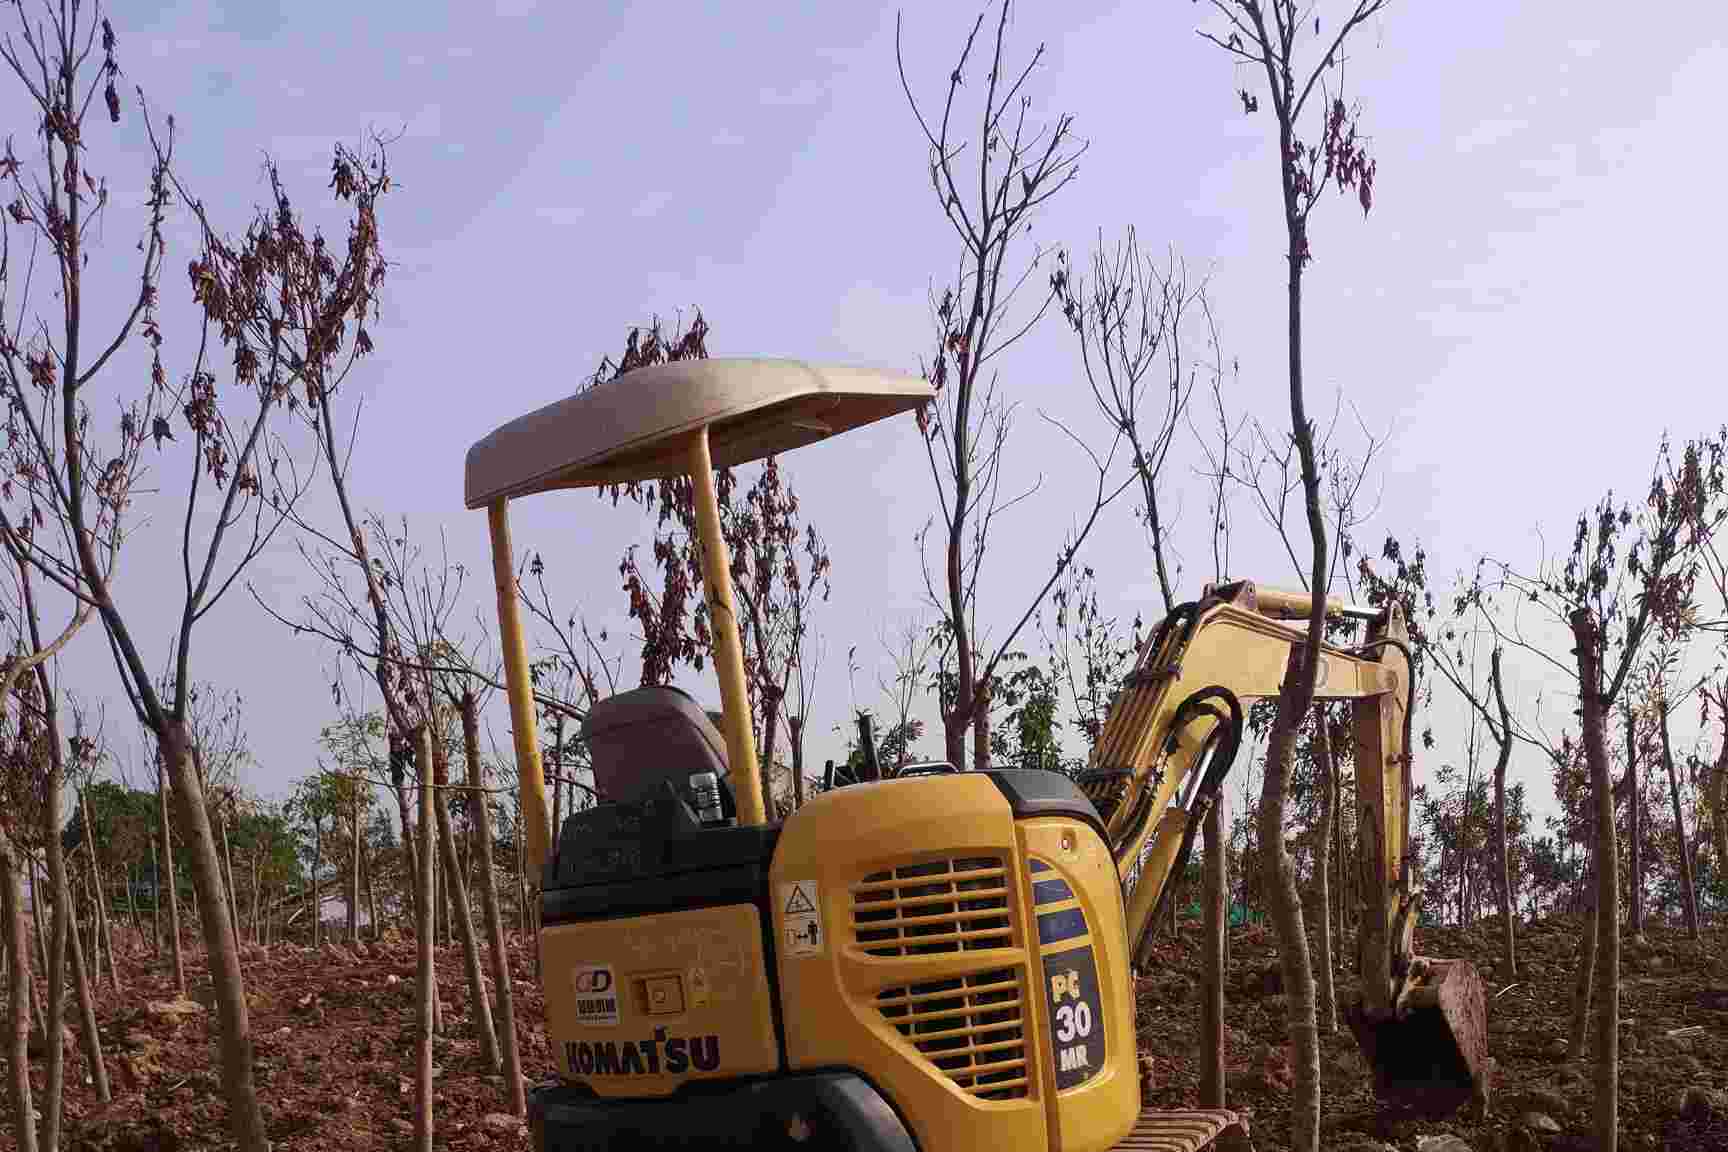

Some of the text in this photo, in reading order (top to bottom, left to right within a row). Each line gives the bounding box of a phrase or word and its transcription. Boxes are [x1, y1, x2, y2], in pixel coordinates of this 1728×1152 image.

[1056, 1002, 1092, 1042] 30
[565, 1025, 721, 1074] KOMATSU
[1060, 1045, 1088, 1072] MR
